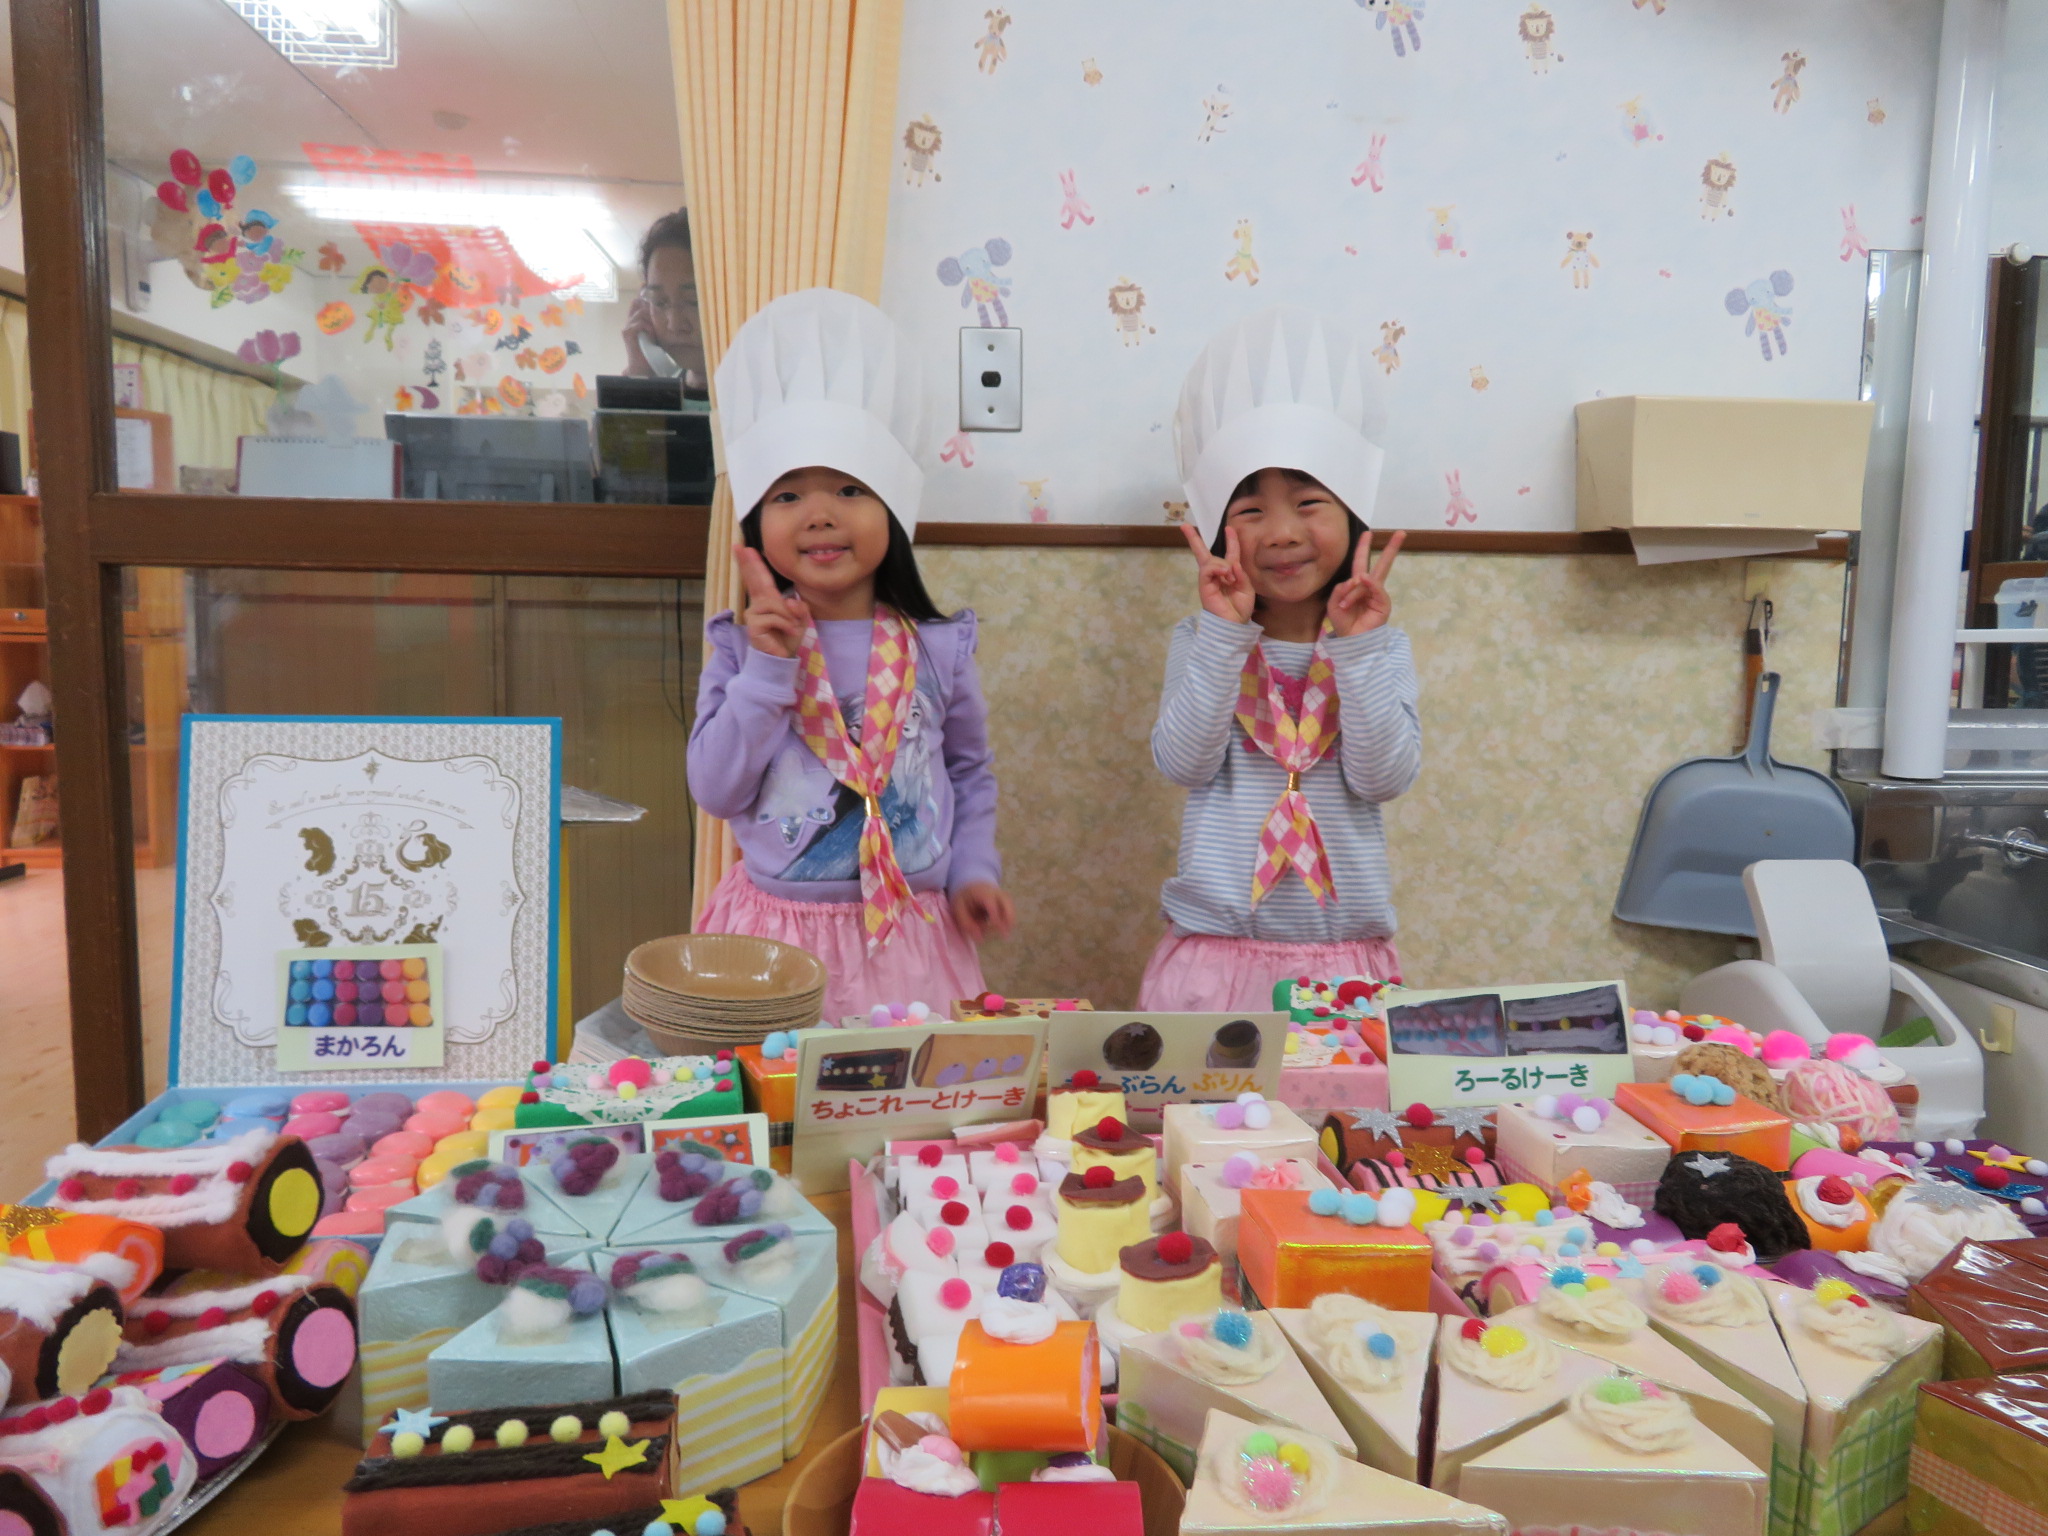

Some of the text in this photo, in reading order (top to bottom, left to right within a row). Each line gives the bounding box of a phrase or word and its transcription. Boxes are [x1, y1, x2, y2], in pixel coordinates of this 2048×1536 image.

[314, 1034, 406, 1057] まかろん
[1065, 1074, 1186, 1095] ぶらん
[1454, 1063, 1590, 1093] ろーるけーき
[810, 1086, 1026, 1120] ちょこれーとけーき
